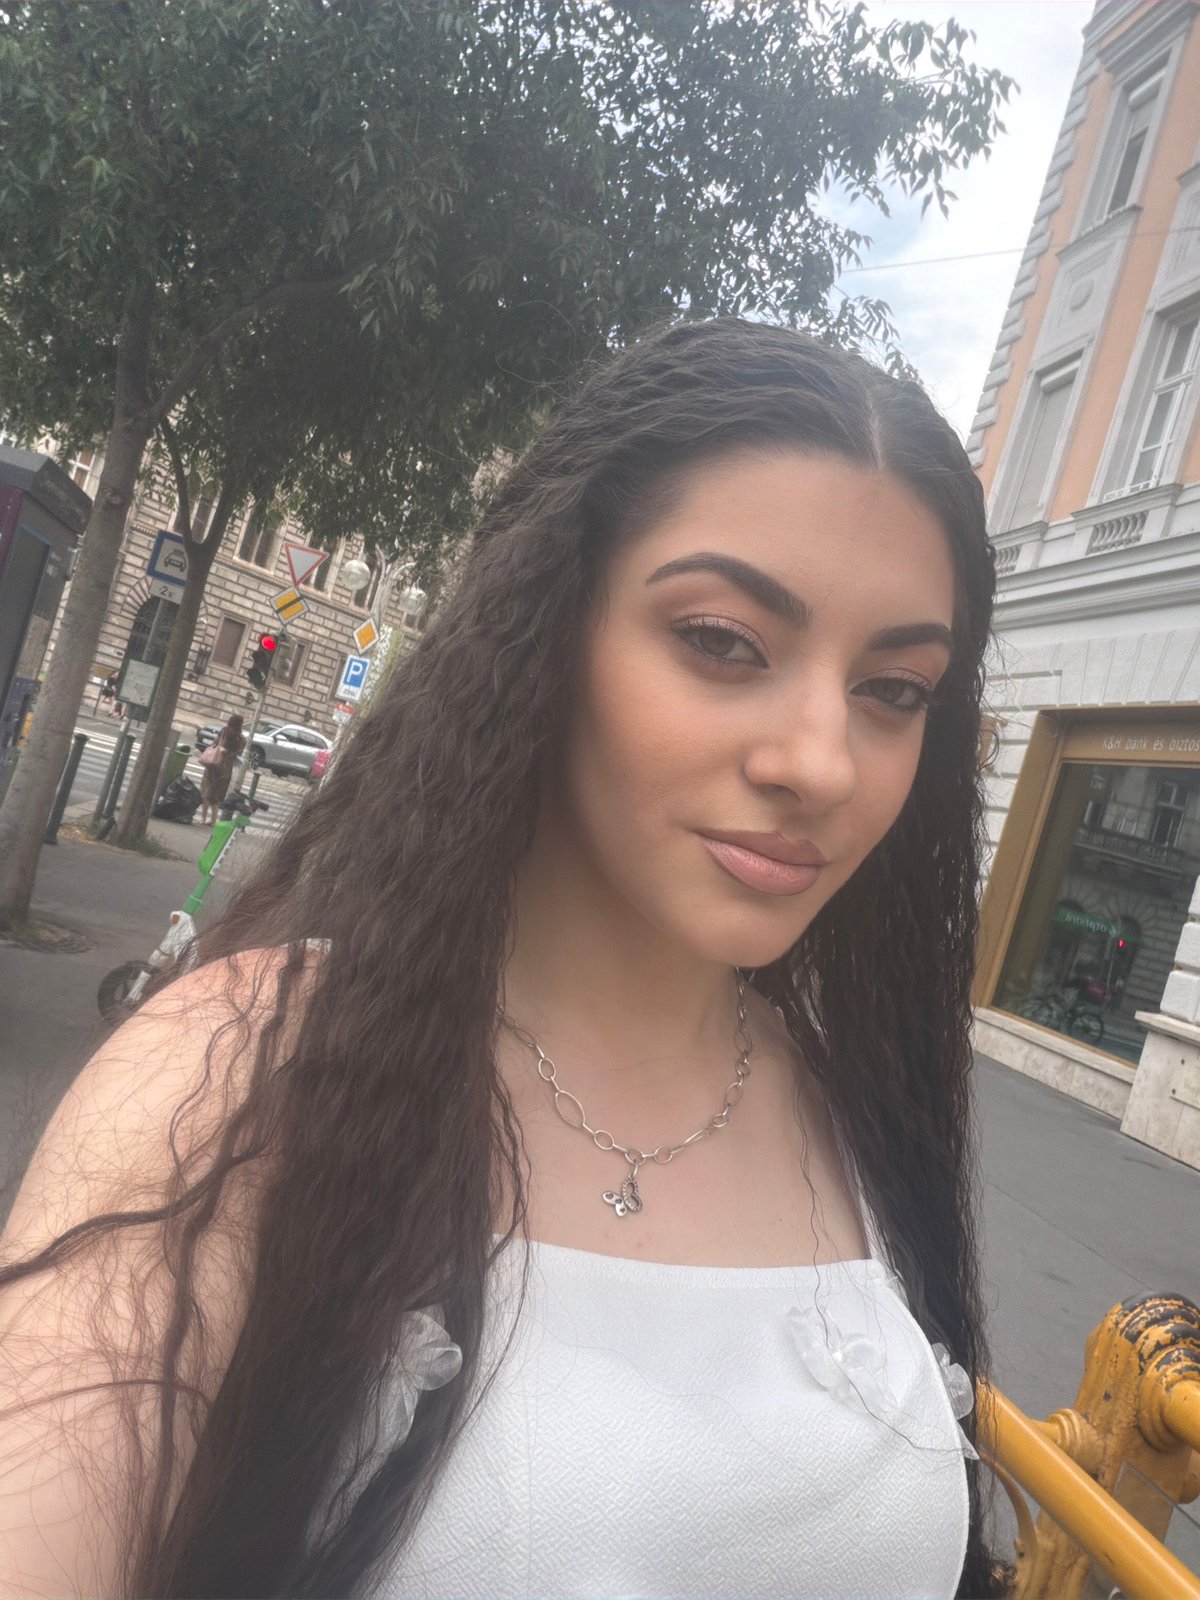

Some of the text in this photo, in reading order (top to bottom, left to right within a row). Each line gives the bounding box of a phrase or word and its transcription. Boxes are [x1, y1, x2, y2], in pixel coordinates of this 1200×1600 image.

[346, 661, 363, 683] P
[1102, 735, 1122, 751] K&H
[1124, 736, 1148, 752] bank
